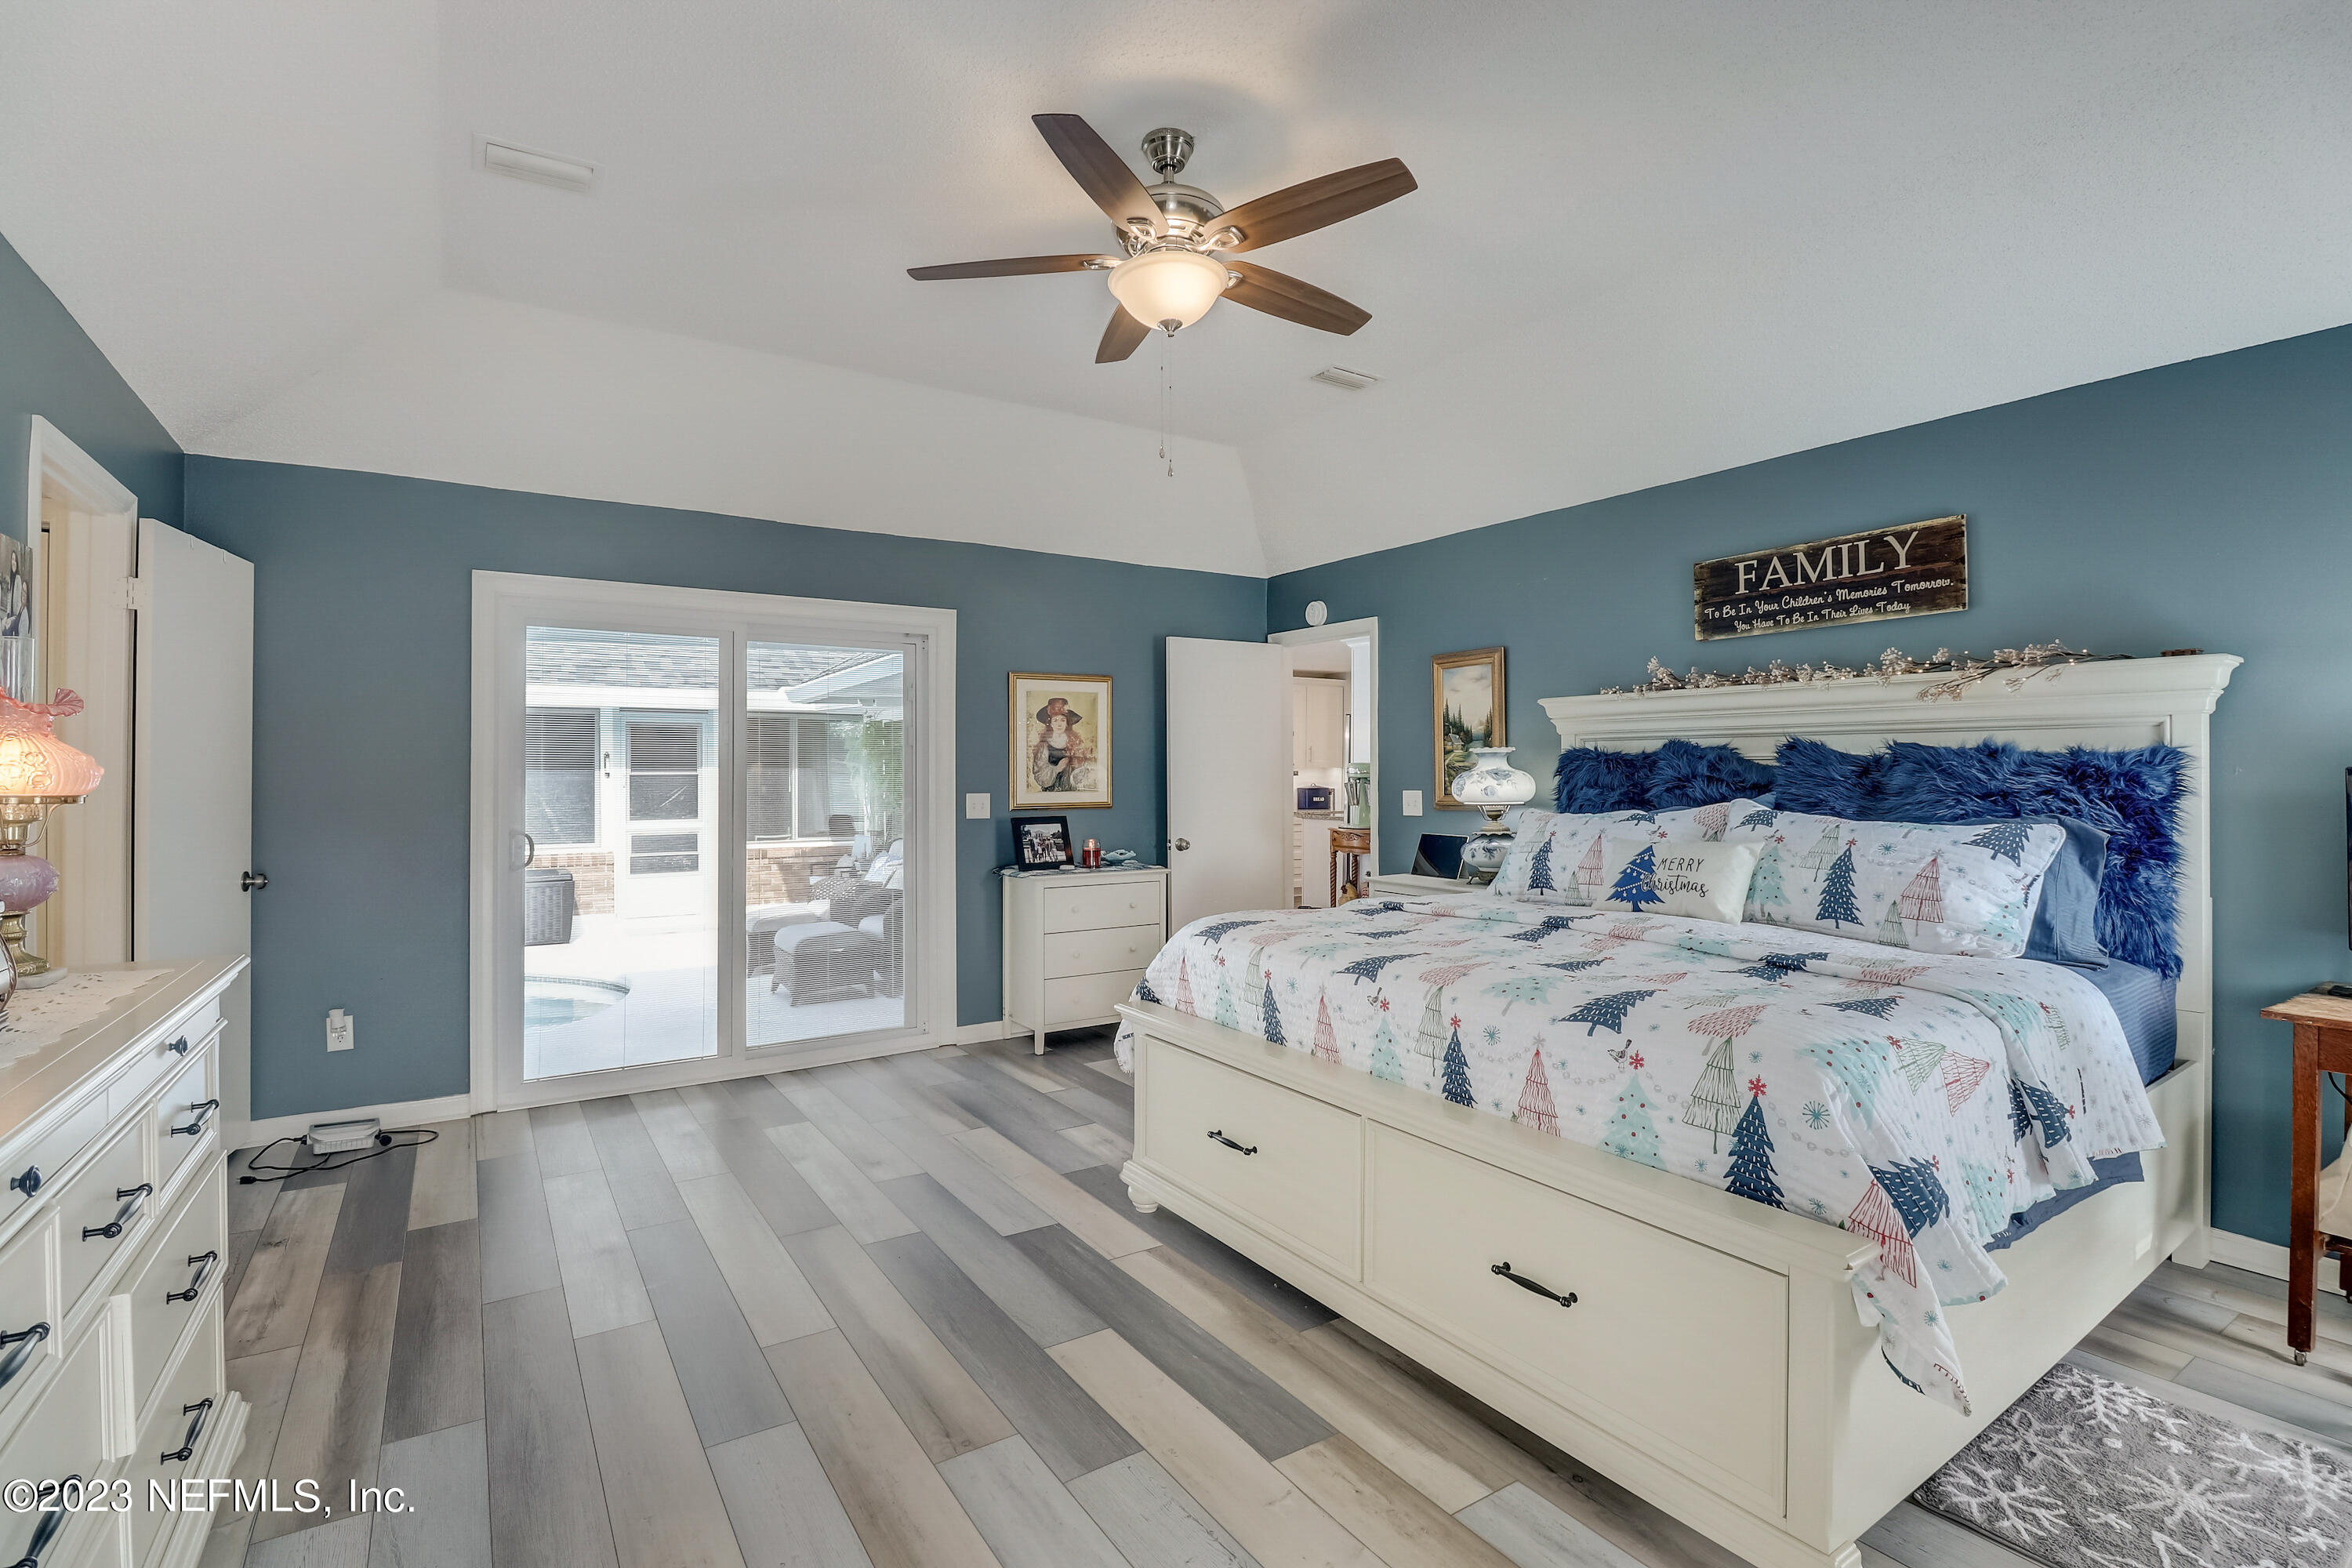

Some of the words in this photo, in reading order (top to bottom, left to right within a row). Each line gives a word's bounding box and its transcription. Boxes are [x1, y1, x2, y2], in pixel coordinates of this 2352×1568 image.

[1734, 531, 1918, 595] FAMILY
[1704, 608, 1719, 619] To
[1722, 605, 1736, 618] Be
[1738, 604, 1752, 615] In
[1755, 600, 1779, 614] Your
[1782, 591, 1832, 608] Children's
[1835, 586, 1887, 601] Memories
[1891, 579, 1954, 593] Tomorrow.
[1734, 620, 1750, 632] You
[1752, 619, 1774, 629] Have
[1776, 615, 1791, 626] To
[1791, 612, 1805, 625] Be
[1806, 612, 1819, 622] In
[1821, 608, 1848, 620] Their
[1849, 604, 1874, 616] Lives
[1876, 601, 1911, 613] Today
[1657, 857, 1704, 873] MERRY
[1641, 873, 1709, 898] Christmas
